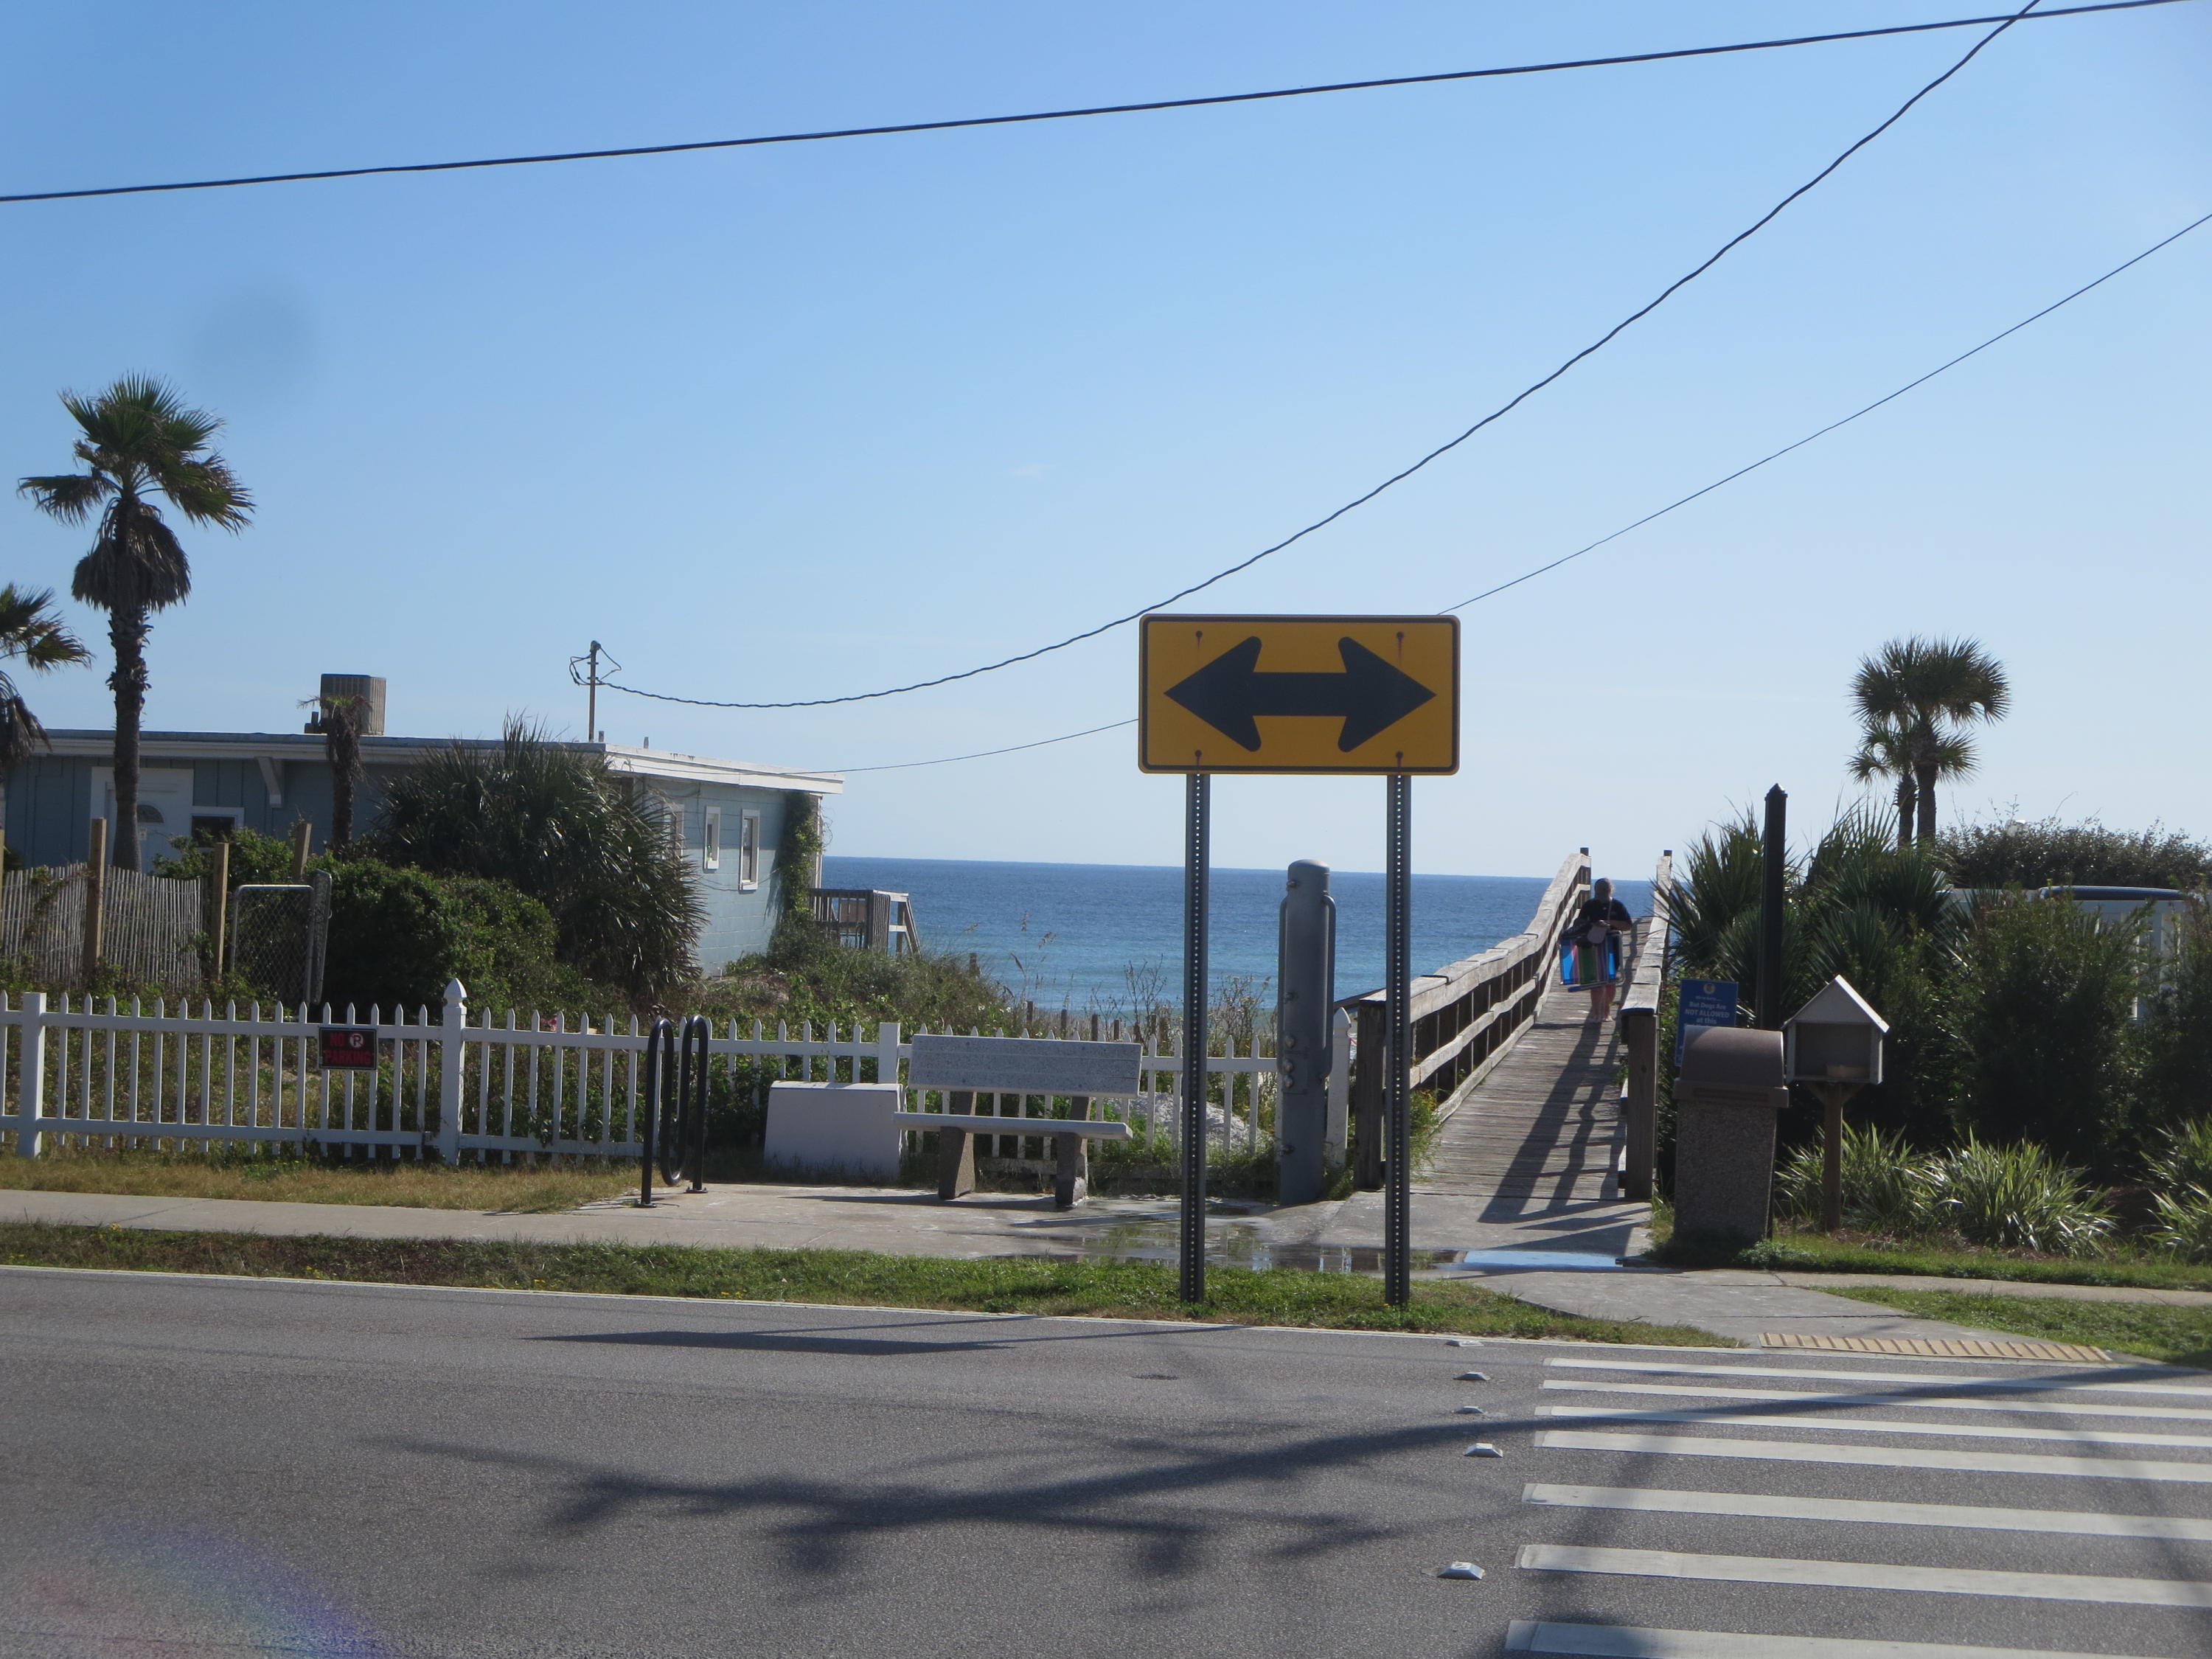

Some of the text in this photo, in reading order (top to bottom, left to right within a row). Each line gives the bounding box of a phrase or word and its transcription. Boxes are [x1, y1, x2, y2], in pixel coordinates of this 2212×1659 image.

[1699, 1010, 1730, 1018] ALLOWED
[330, 1032, 344, 1046] NO
[323, 1050, 372, 1065] PARKING
